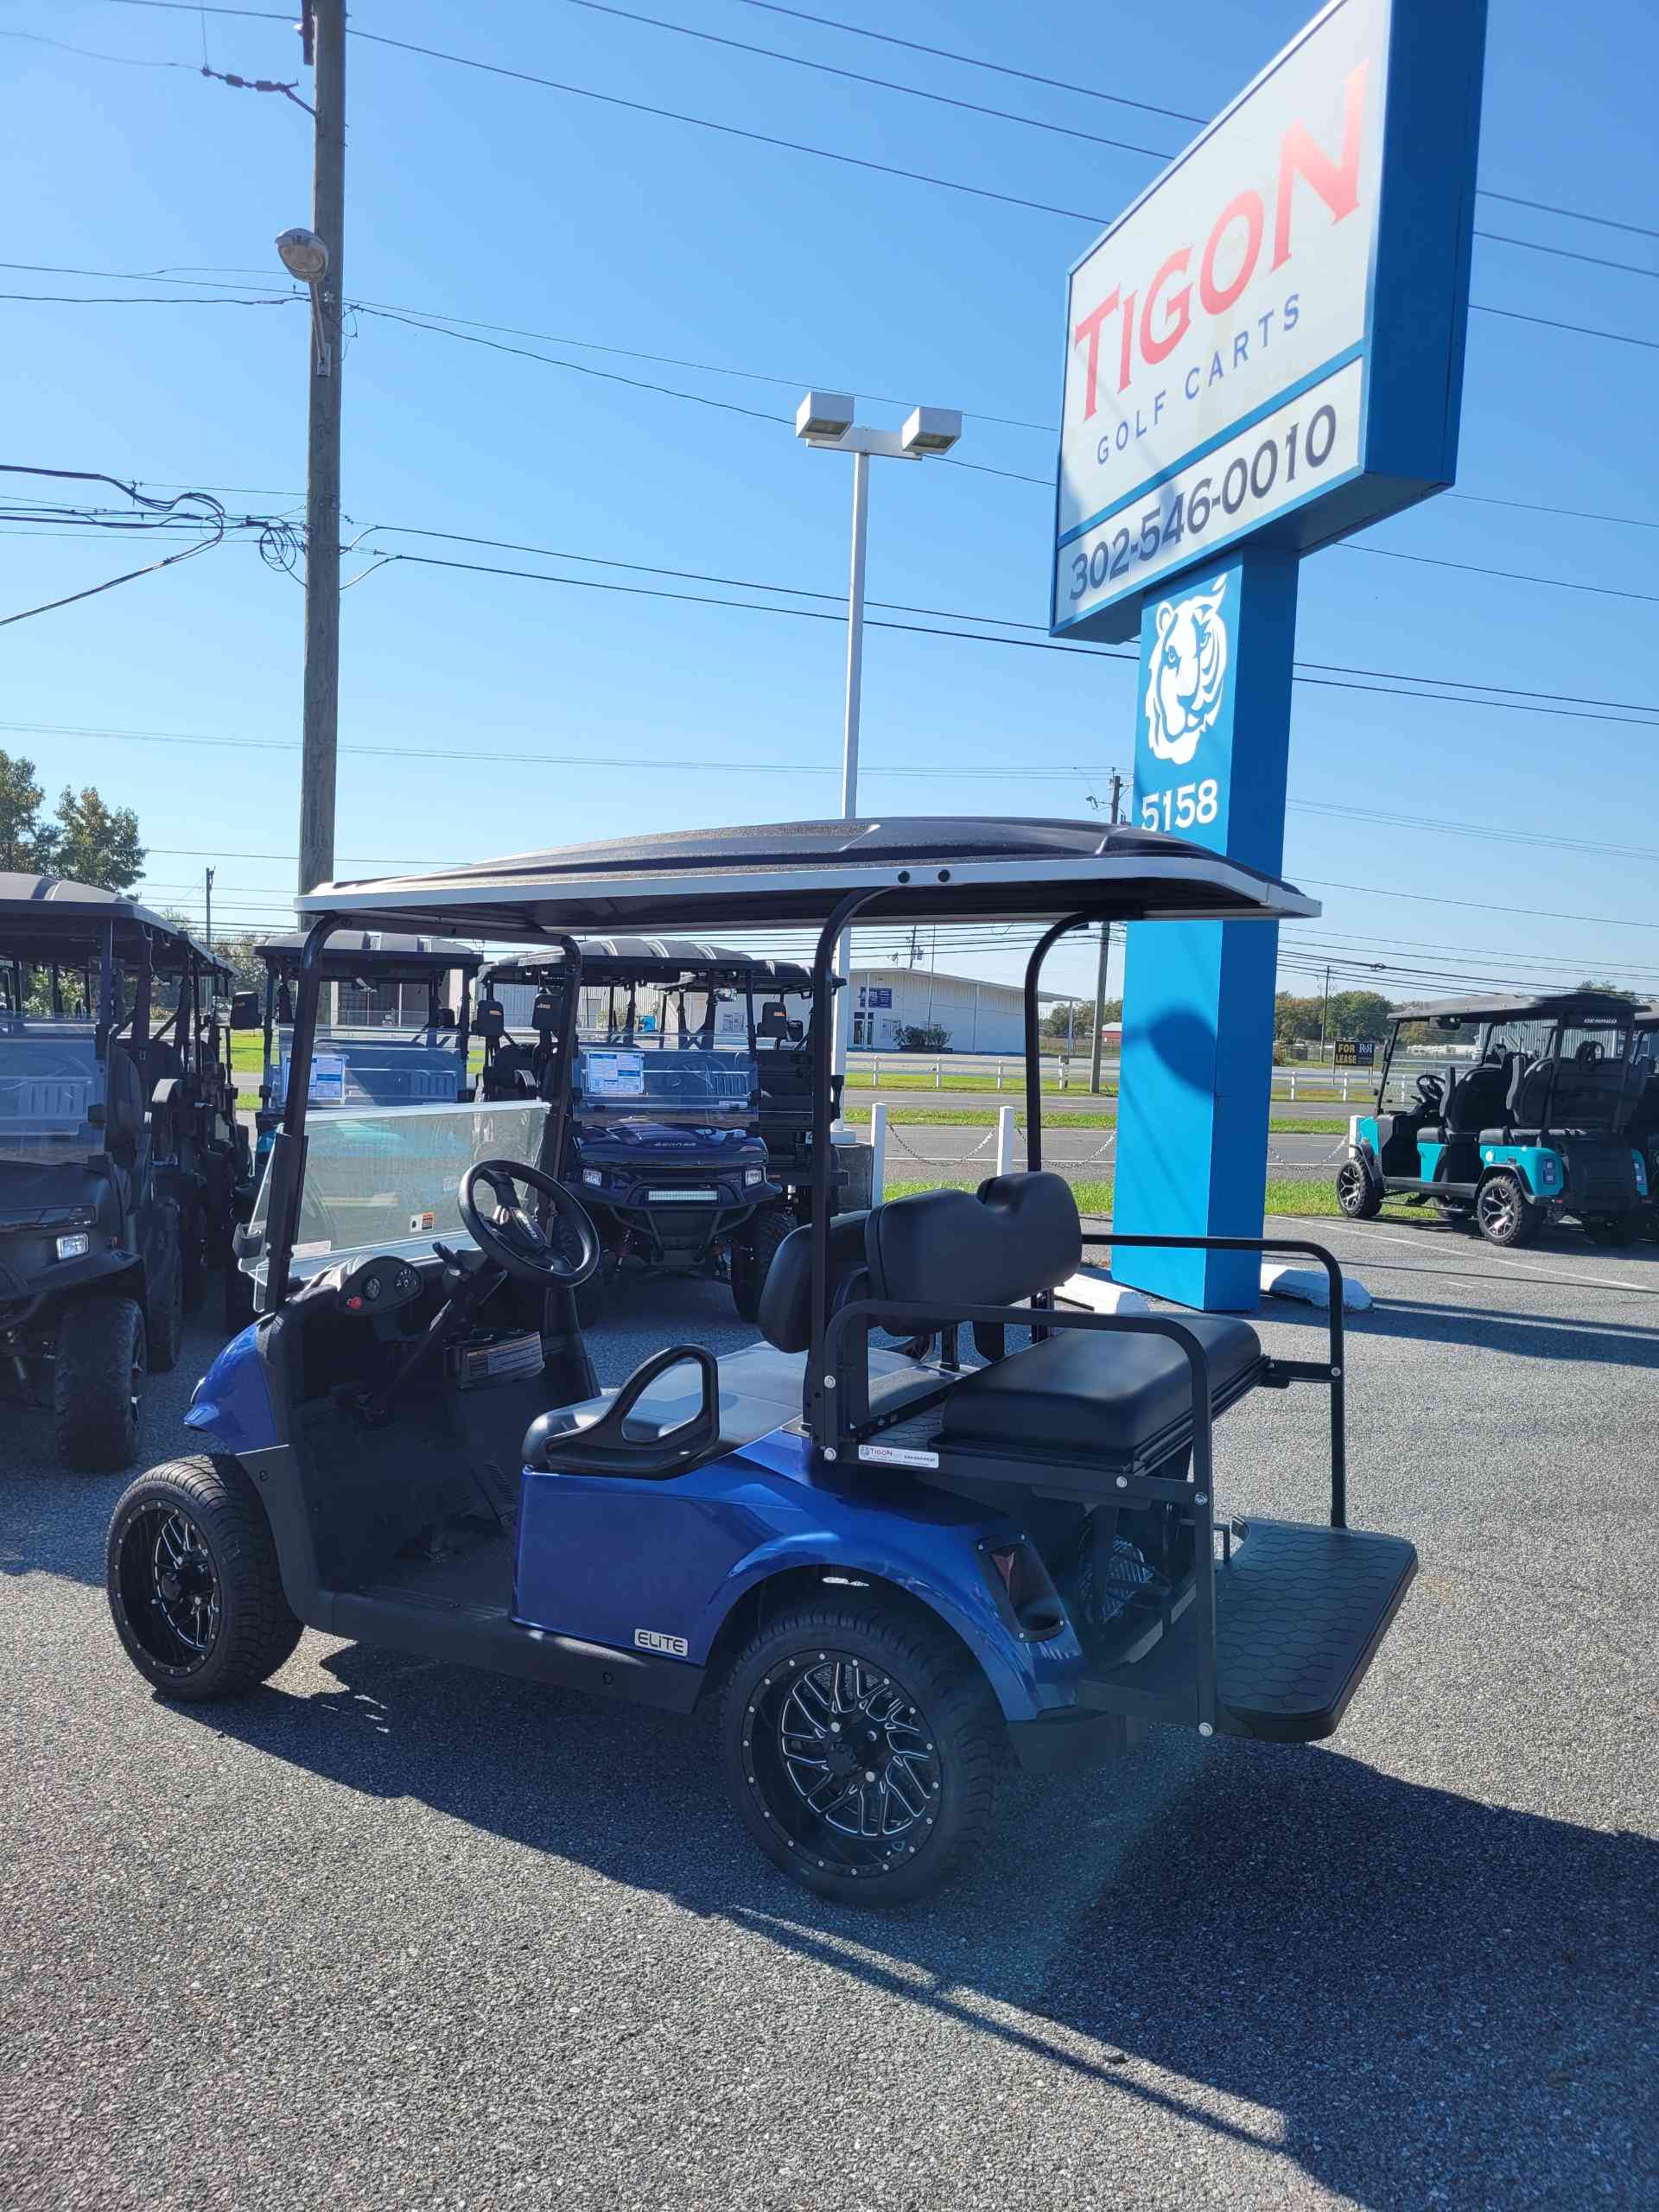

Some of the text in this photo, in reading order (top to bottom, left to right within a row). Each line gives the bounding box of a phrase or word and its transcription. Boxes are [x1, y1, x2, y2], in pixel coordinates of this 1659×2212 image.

[1074, 56, 1370, 423] TIGON
[1096, 293, 1300, 466] GOLF CARTS
[1069, 404, 1337, 601] 302-546-0010
[1141, 779, 1217, 833] 5158
[1335, 1053, 1357, 1065] LEASE
[1338, 1043, 1356, 1053] FOR
[870, 1447, 893, 1457] TIGON
